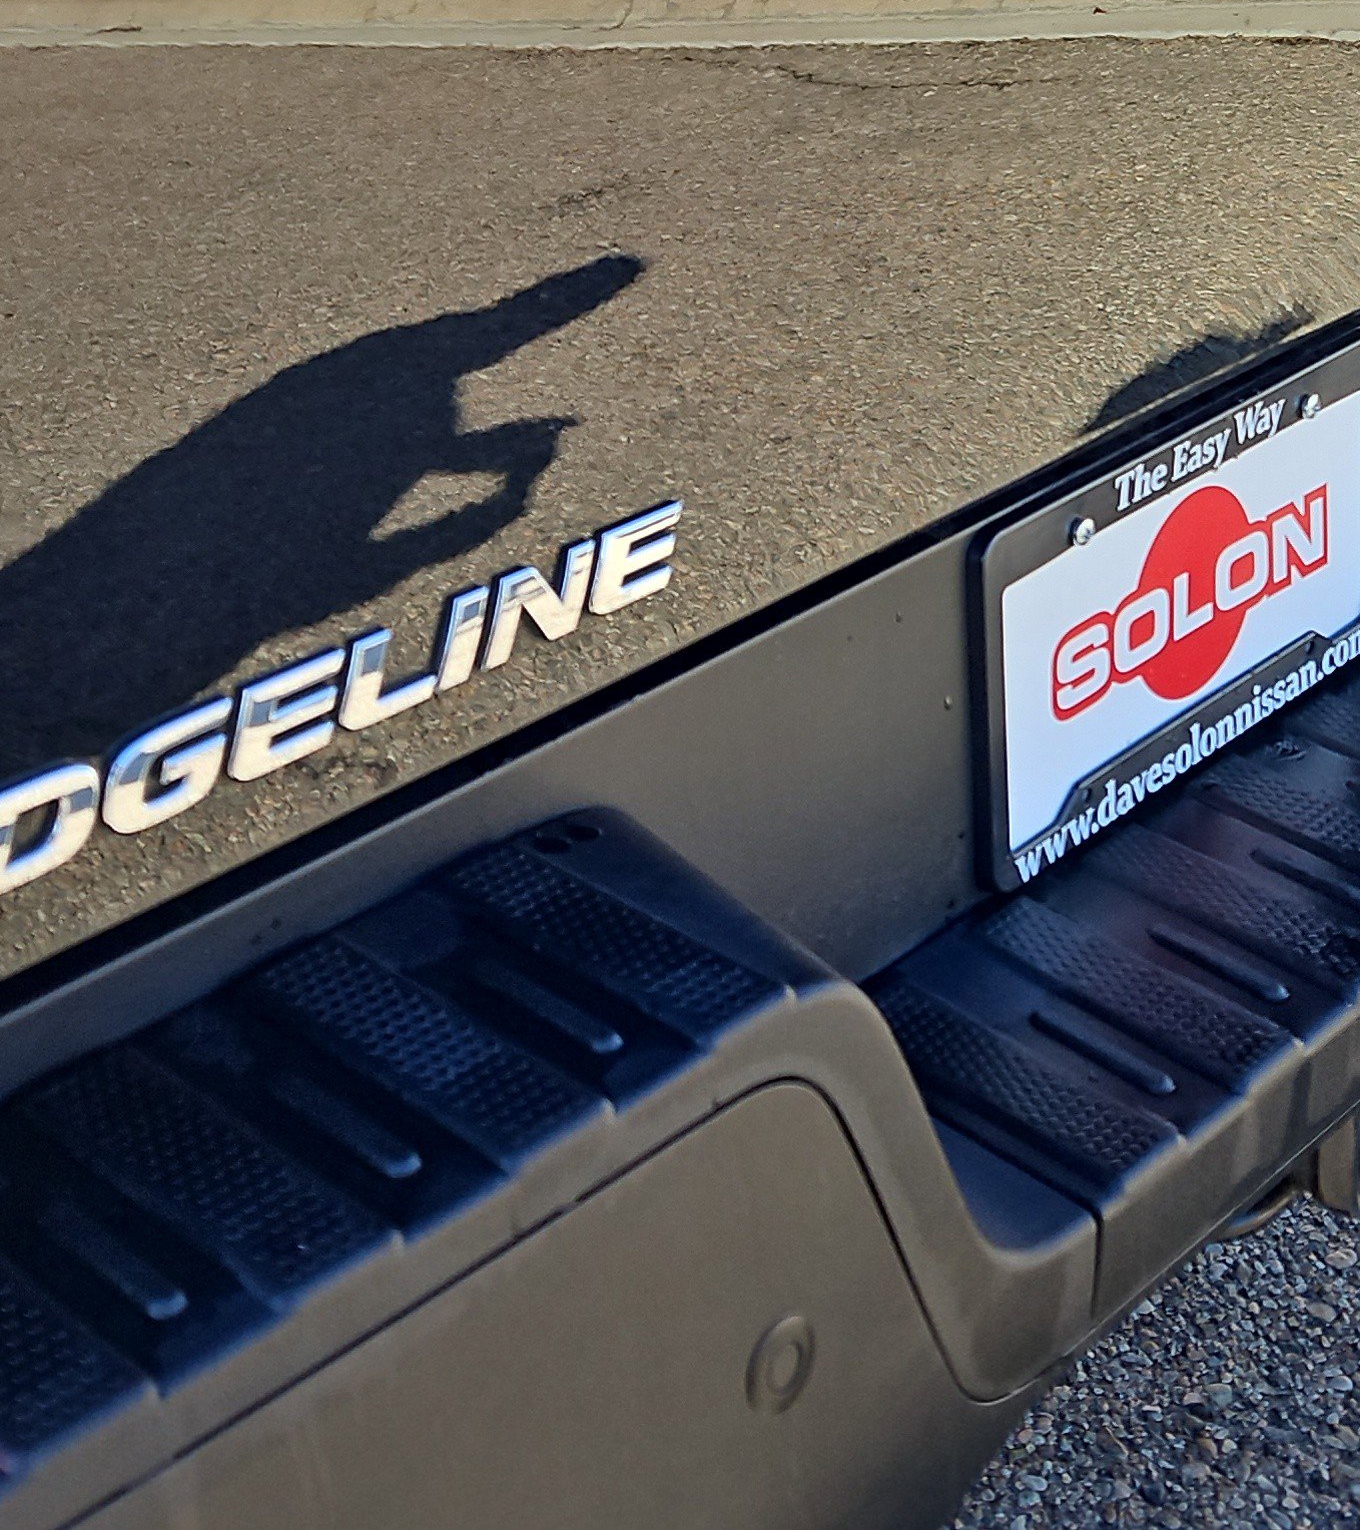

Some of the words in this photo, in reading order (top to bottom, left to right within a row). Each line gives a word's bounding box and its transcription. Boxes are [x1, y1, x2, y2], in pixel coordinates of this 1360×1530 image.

[1115, 464, 1168, 511] The
[1171, 428, 1231, 482] Easy
[1234, 398, 1286, 445] Way
[1052, 484, 1329, 720] SOLON
